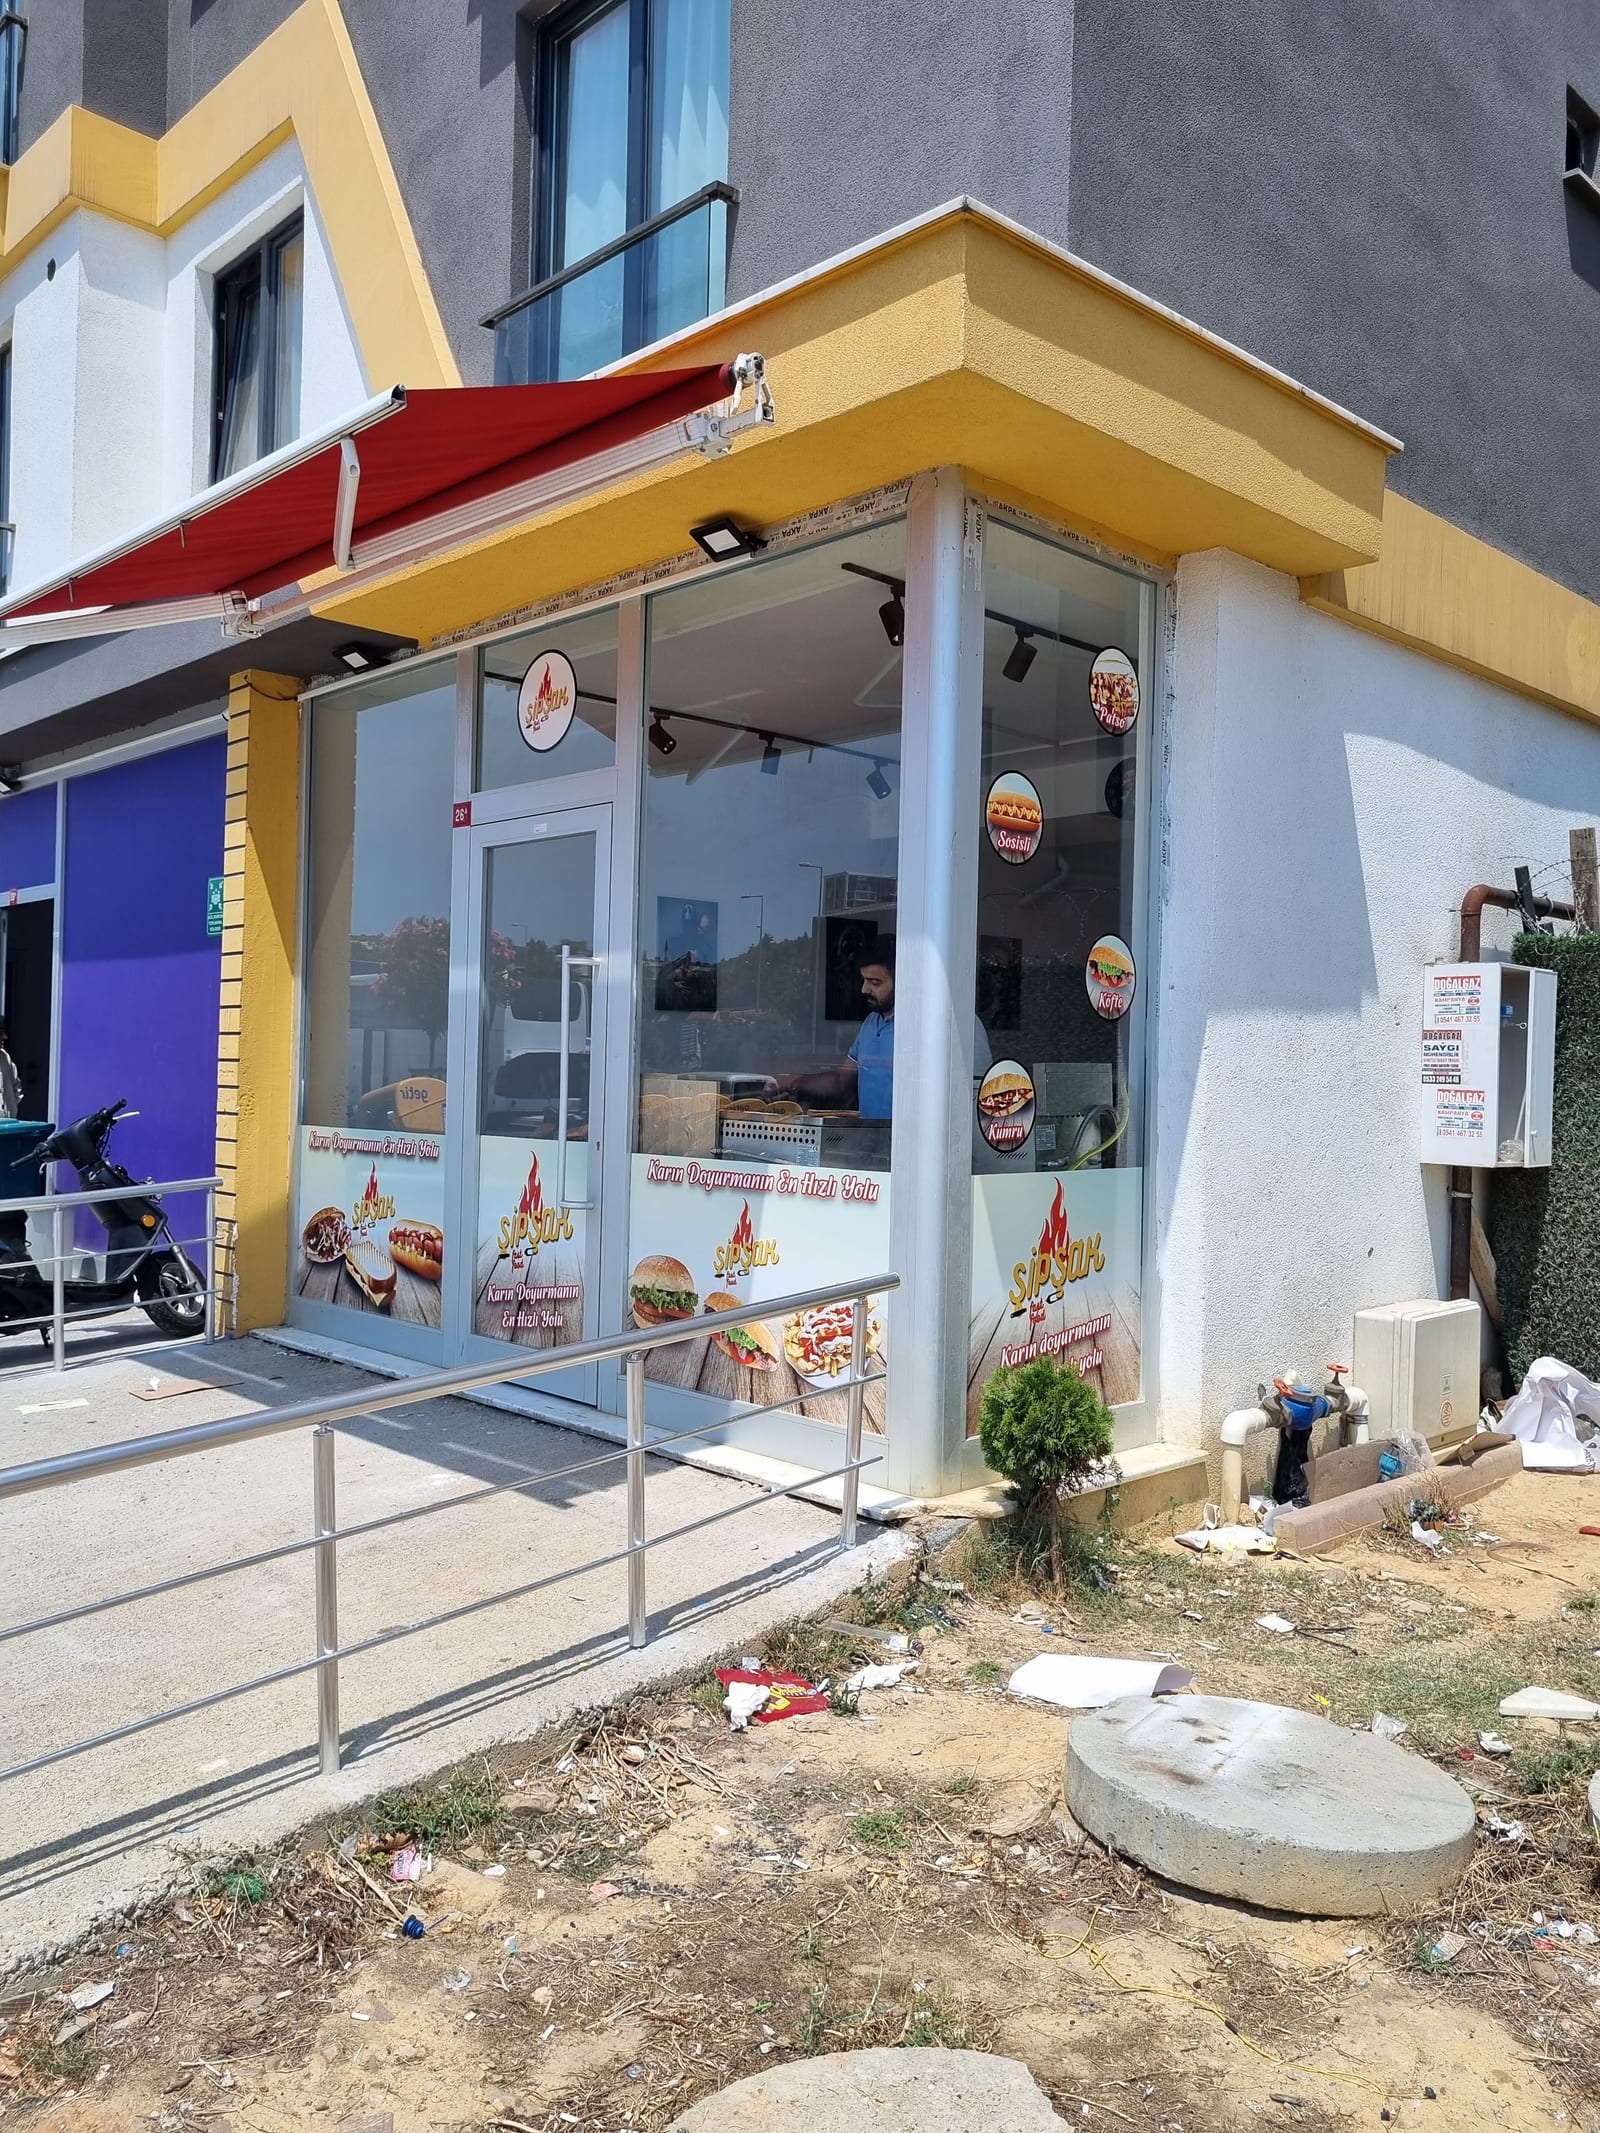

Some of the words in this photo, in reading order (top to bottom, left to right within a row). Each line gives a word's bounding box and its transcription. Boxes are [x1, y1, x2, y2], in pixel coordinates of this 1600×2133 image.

[809, 506, 829, 519] AKPA
[855, 500, 876, 514] AKPA
[999, 503, 1017, 516] AKPA
[782, 525, 801, 538] AKPA
[1063, 530, 1079, 542] AKPA
[1122, 554, 1138, 566] AKPA
[1100, 706, 1126, 729] Patso
[997, 830, 1032, 852] Sosisli
[1098, 991, 1123, 1012] Köfte
[988, 1123, 1024, 1141] Kumru
[309, 1131, 330, 1148] Karın
[332, 1132, 382, 1155] Doyurmanın
[383, 1136, 395, 1153] En
[396, 1138, 417, 1156] Hızlı
[418, 1139, 440, 1159] Yolu
[647, 1159, 684, 1184] Karın
[687, 1161, 775, 1192] Doyurmanın
[776, 1169, 799, 1194] En
[800, 1172, 839, 1198] Hızlı
[841, 1175, 880, 1201] Yolu
[487, 1284, 514, 1303] Karın
[516, 1282, 579, 1305] Doyurmanın
[502, 1310, 515, 1328] En
[516, 1310, 539, 1328] Hızlı
[540, 1310, 564, 1328] Yolu
[999, 1342, 1037, 1368] Karın
[1039, 1313, 1112, 1354] doyurmanın
[1078, 1347, 1104, 1377] yolu
